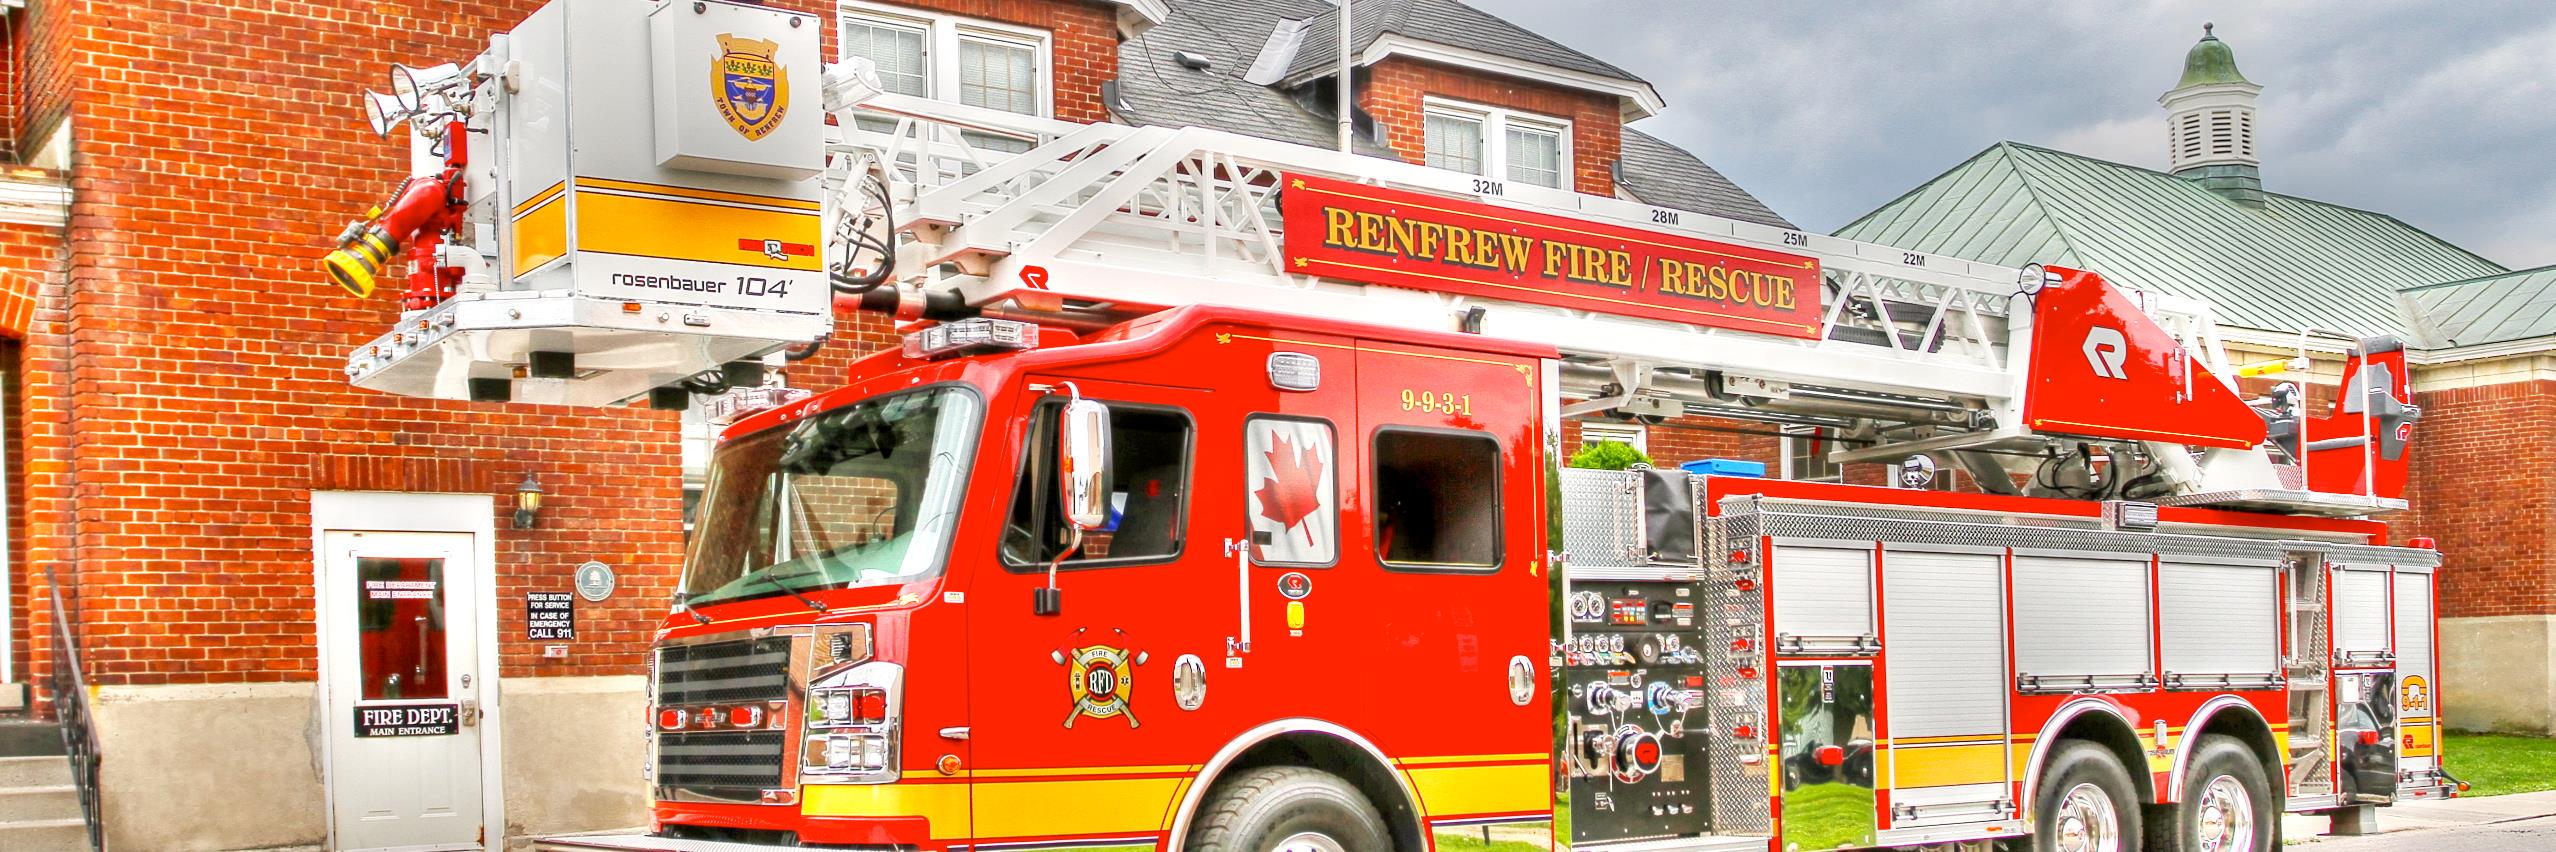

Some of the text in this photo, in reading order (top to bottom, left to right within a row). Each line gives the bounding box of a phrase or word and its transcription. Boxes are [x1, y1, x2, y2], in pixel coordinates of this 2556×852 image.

[717, 97, 785, 136] TOWN OF RENFREW
[1473, 179, 1503, 196] 32M
[1651, 209, 1679, 226] 28M
[1783, 232, 1808, 247] 25M
[1323, 206, 1796, 311] RENFREW FIRE / RESCUE
[1903, 252, 1926, 267] 22M
[612, 273, 727, 293] rosenbauer
[1401, 388, 1472, 416] 9-9-3-1
[530, 629, 572, 638] CALL 911
[1092, 650, 1108, 658] FIRE
[1089, 669, 1114, 694] RFD
[1087, 703, 1116, 714] RESCUE
[2402, 695, 2428, 711] 9-1-1
[363, 708, 452, 726] FIRE DEPT.
[369, 726, 446, 736] MAIN ENTRANCE
